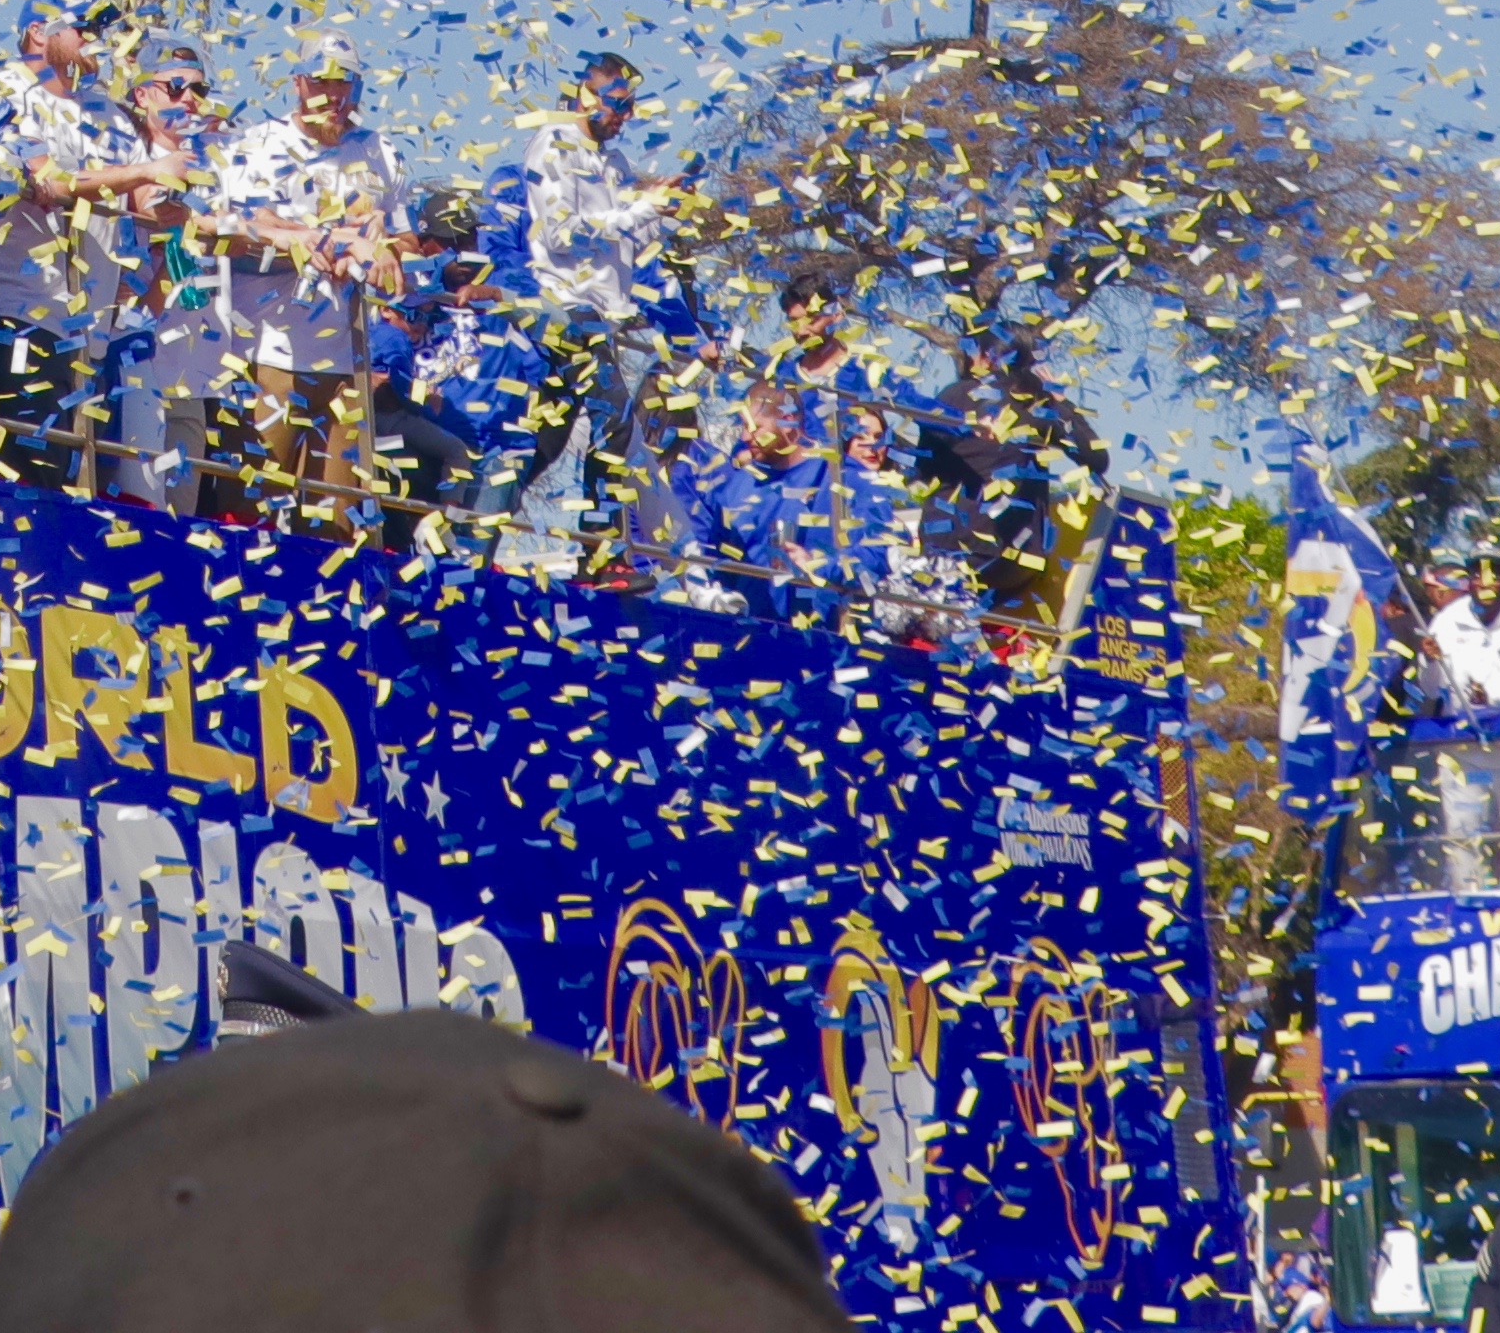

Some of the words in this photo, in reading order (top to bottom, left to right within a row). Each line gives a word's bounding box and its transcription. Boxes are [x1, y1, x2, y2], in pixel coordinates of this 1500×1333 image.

[1096, 614, 1127, 638] LOS
[1099, 636, 1167, 666] ANGES
[1099, 658, 1145, 685] RAMS
